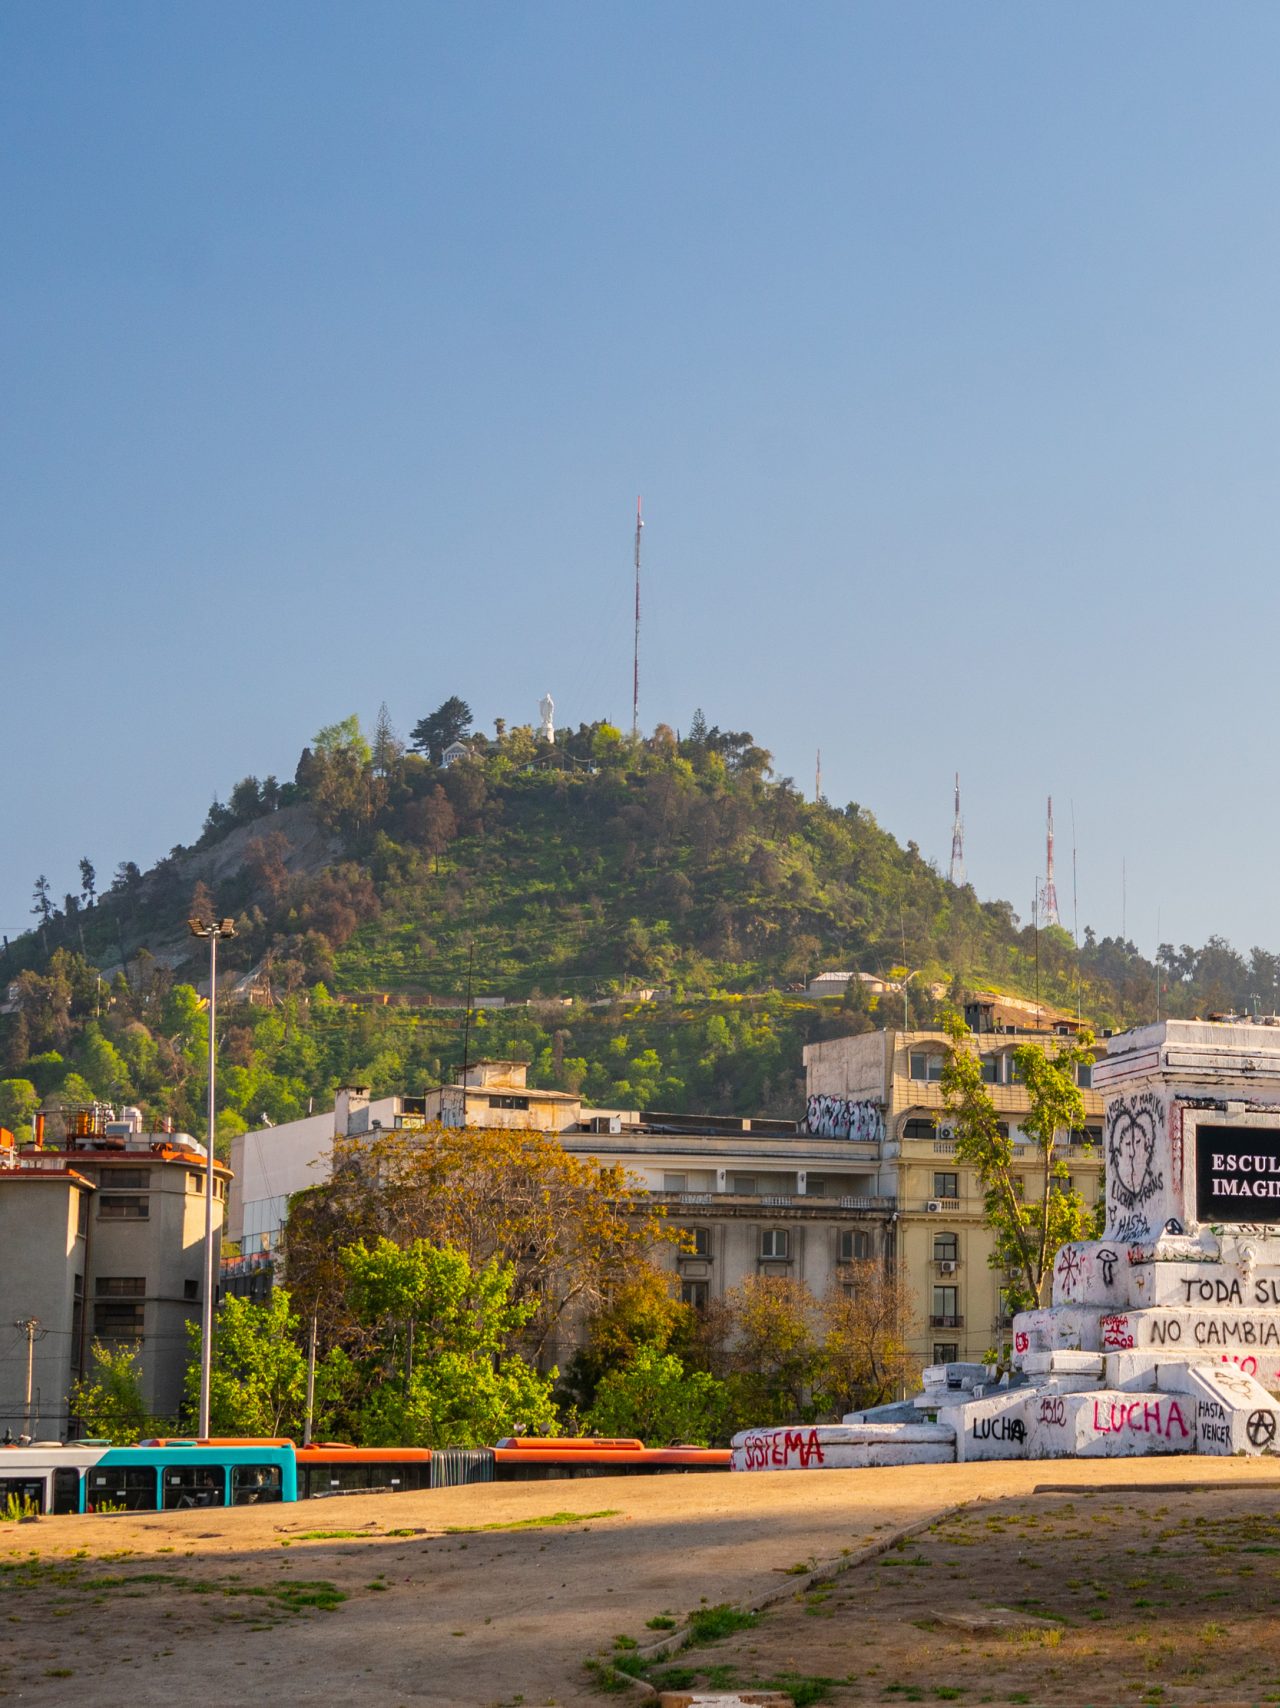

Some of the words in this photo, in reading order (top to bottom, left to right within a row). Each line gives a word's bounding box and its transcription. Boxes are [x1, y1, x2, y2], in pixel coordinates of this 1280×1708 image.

[1181, 1278, 1243, 1304] TODA
[1150, 1320, 1182, 1345] NO
[1040, 1398, 1067, 1427] 1312
[1093, 1400, 1190, 1439] LUCHA
[1198, 1400, 1225, 1421] HASTA
[973, 1416, 1027, 1444] LUCHA
[1201, 1423, 1232, 1447] VENCER
